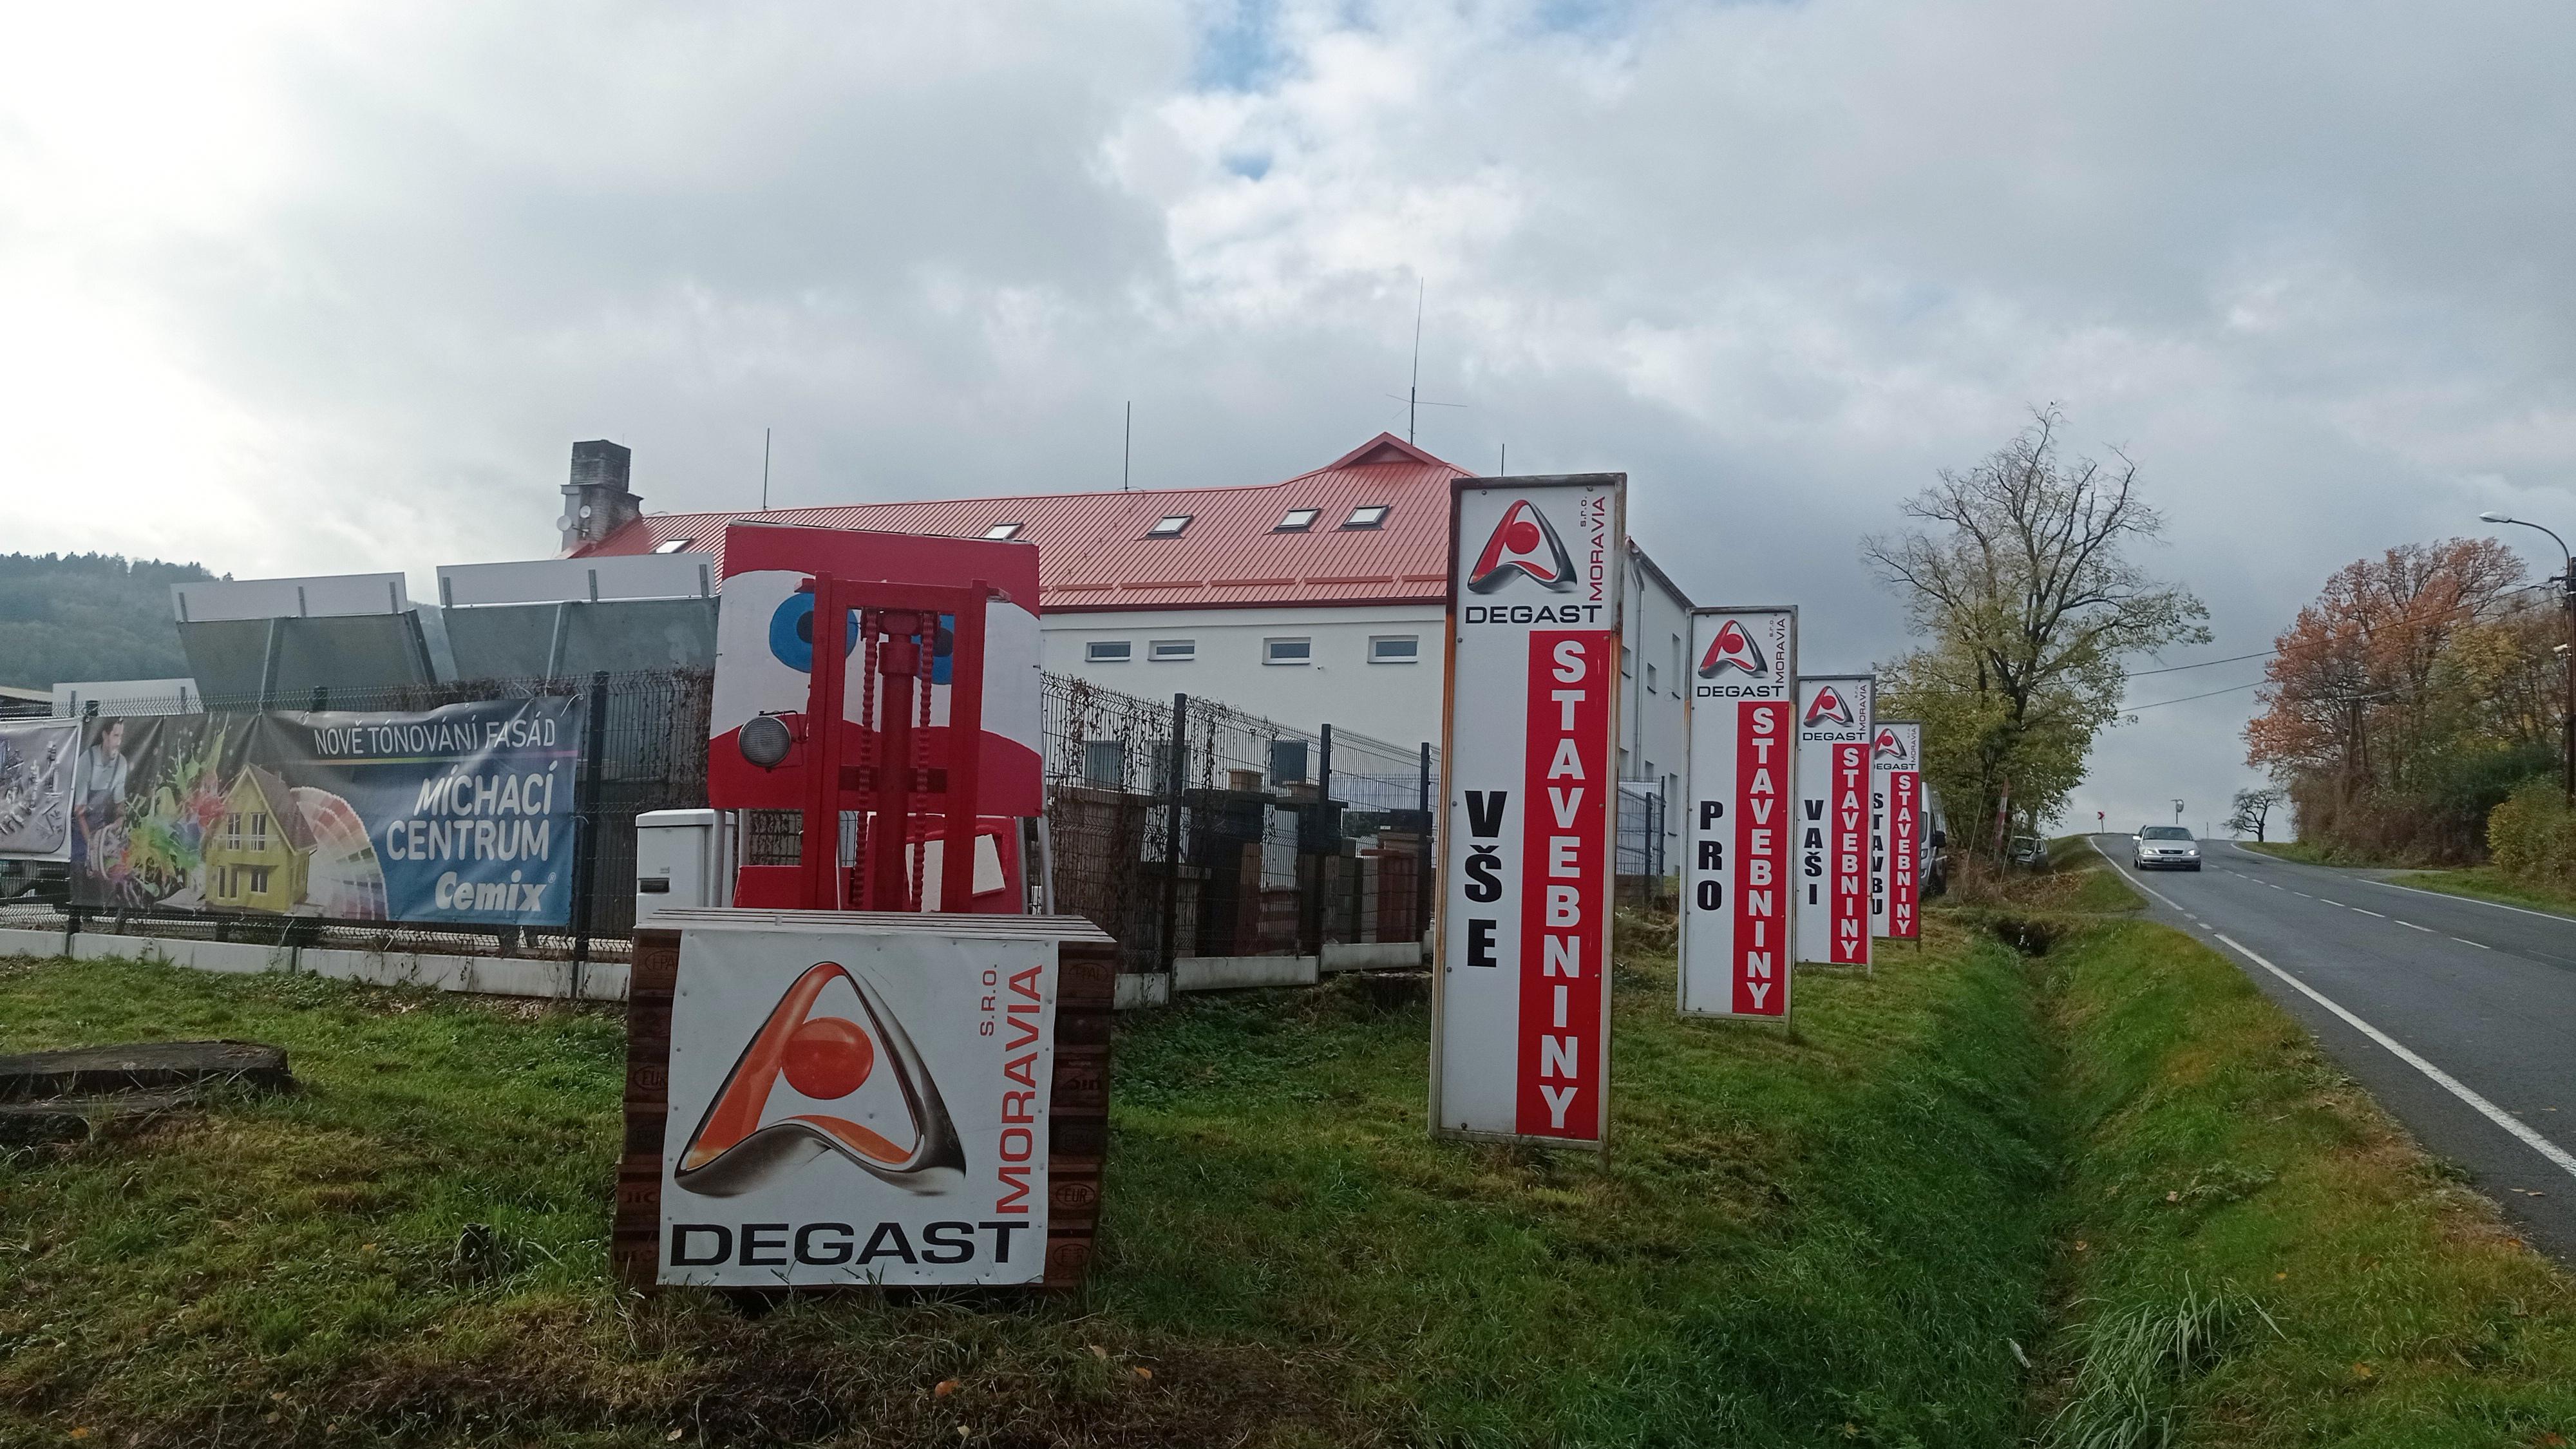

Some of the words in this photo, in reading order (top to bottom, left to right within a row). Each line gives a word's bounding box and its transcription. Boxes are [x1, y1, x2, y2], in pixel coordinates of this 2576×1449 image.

[1589, 496, 1605, 601] MORAVIA
[1465, 605, 1602, 623] DEGAST
[1776, 618, 1785, 683] MORAVIA
[1697, 685, 1784, 697] DEGAST
[368, 714, 478, 753] TÓNOVÁNÍ
[485, 710, 556, 749] FASÁD
[1803, 732, 1866, 741] DEGAST
[413, 760, 558, 817] MÍCHACÍ
[386, 819, 549, 862] CENTRUM
[1697, 800, 1723, 911] PRO
[1746, 707, 1774, 1010] STAVEBNINY
[1804, 800, 1824, 905] VAŠI
[1841, 747, 1860, 959] STAVEBNINY
[1896, 775, 1911, 934] STAVEBNINY
[1464, 790, 1508, 967] VŠE
[1538, 639, 1587, 1129] STAVEBNINY
[979, 964, 997, 1036] S.R.O.
[995, 965, 1043, 1214] MORAVIA
[1064, 1188, 1088, 1203] EUR
[670, 1221, 1030, 1267] DEGAST
